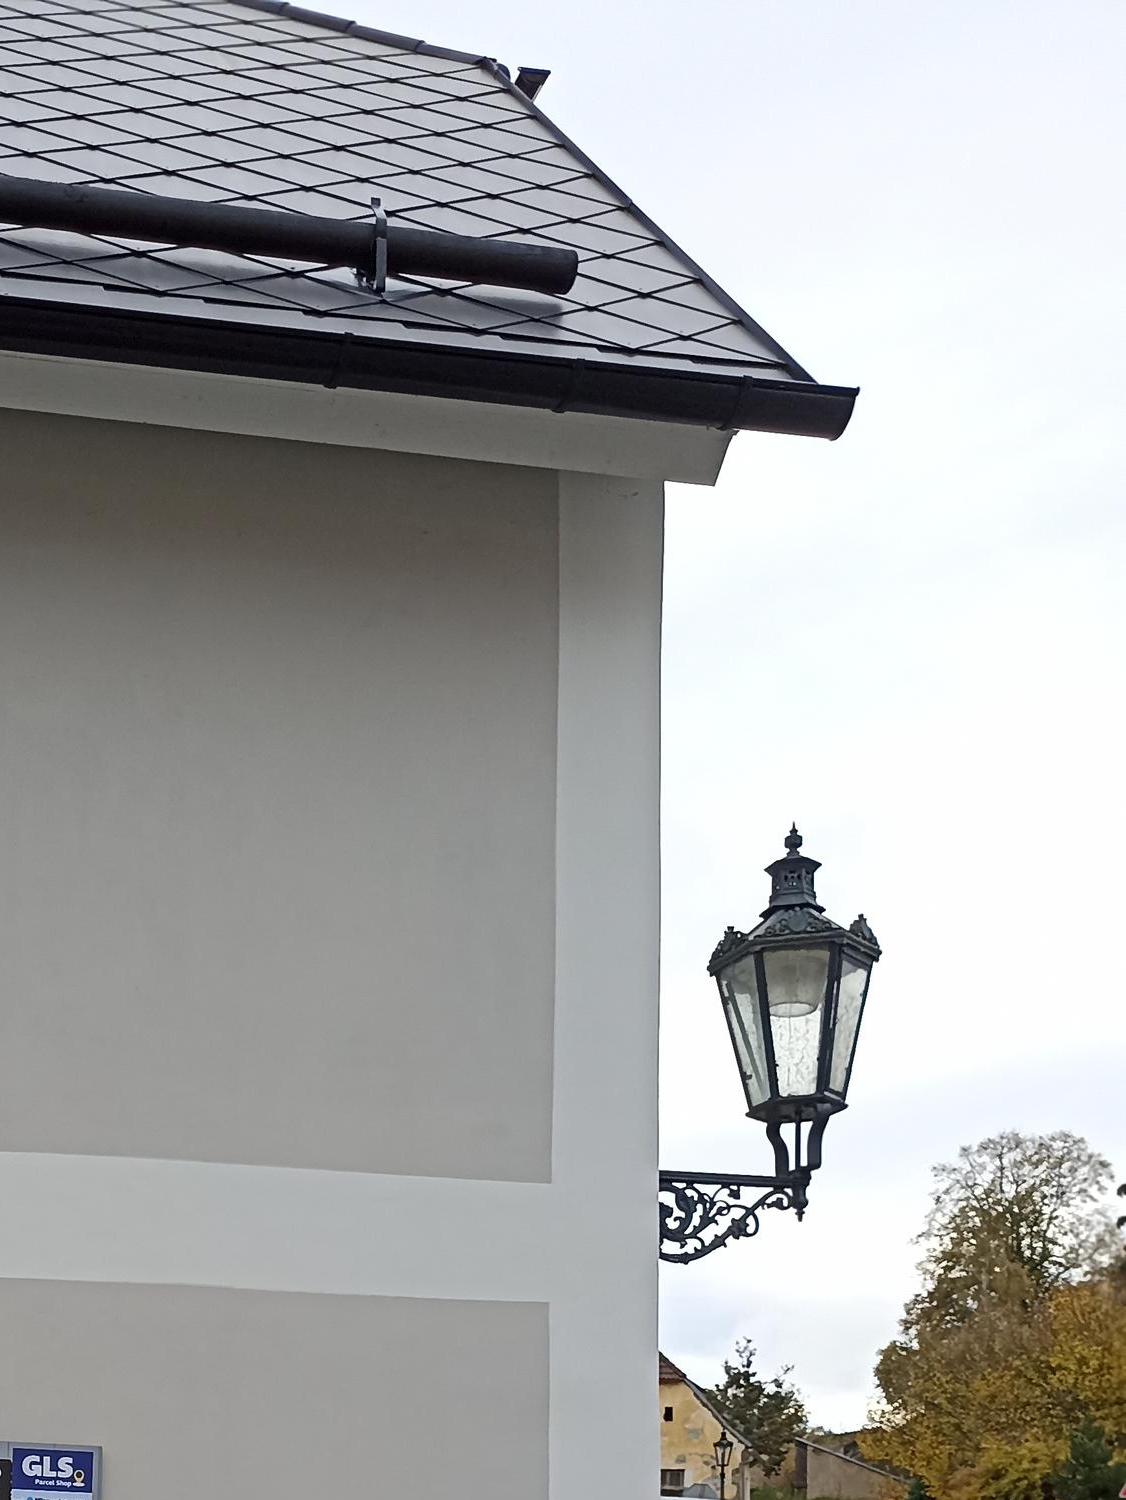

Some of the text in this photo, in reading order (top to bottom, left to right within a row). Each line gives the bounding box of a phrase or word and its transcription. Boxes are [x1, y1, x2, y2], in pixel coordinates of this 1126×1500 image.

[22, 1455, 74, 1478] GLS
[34, 1478, 72, 1488] Parcel Shop
